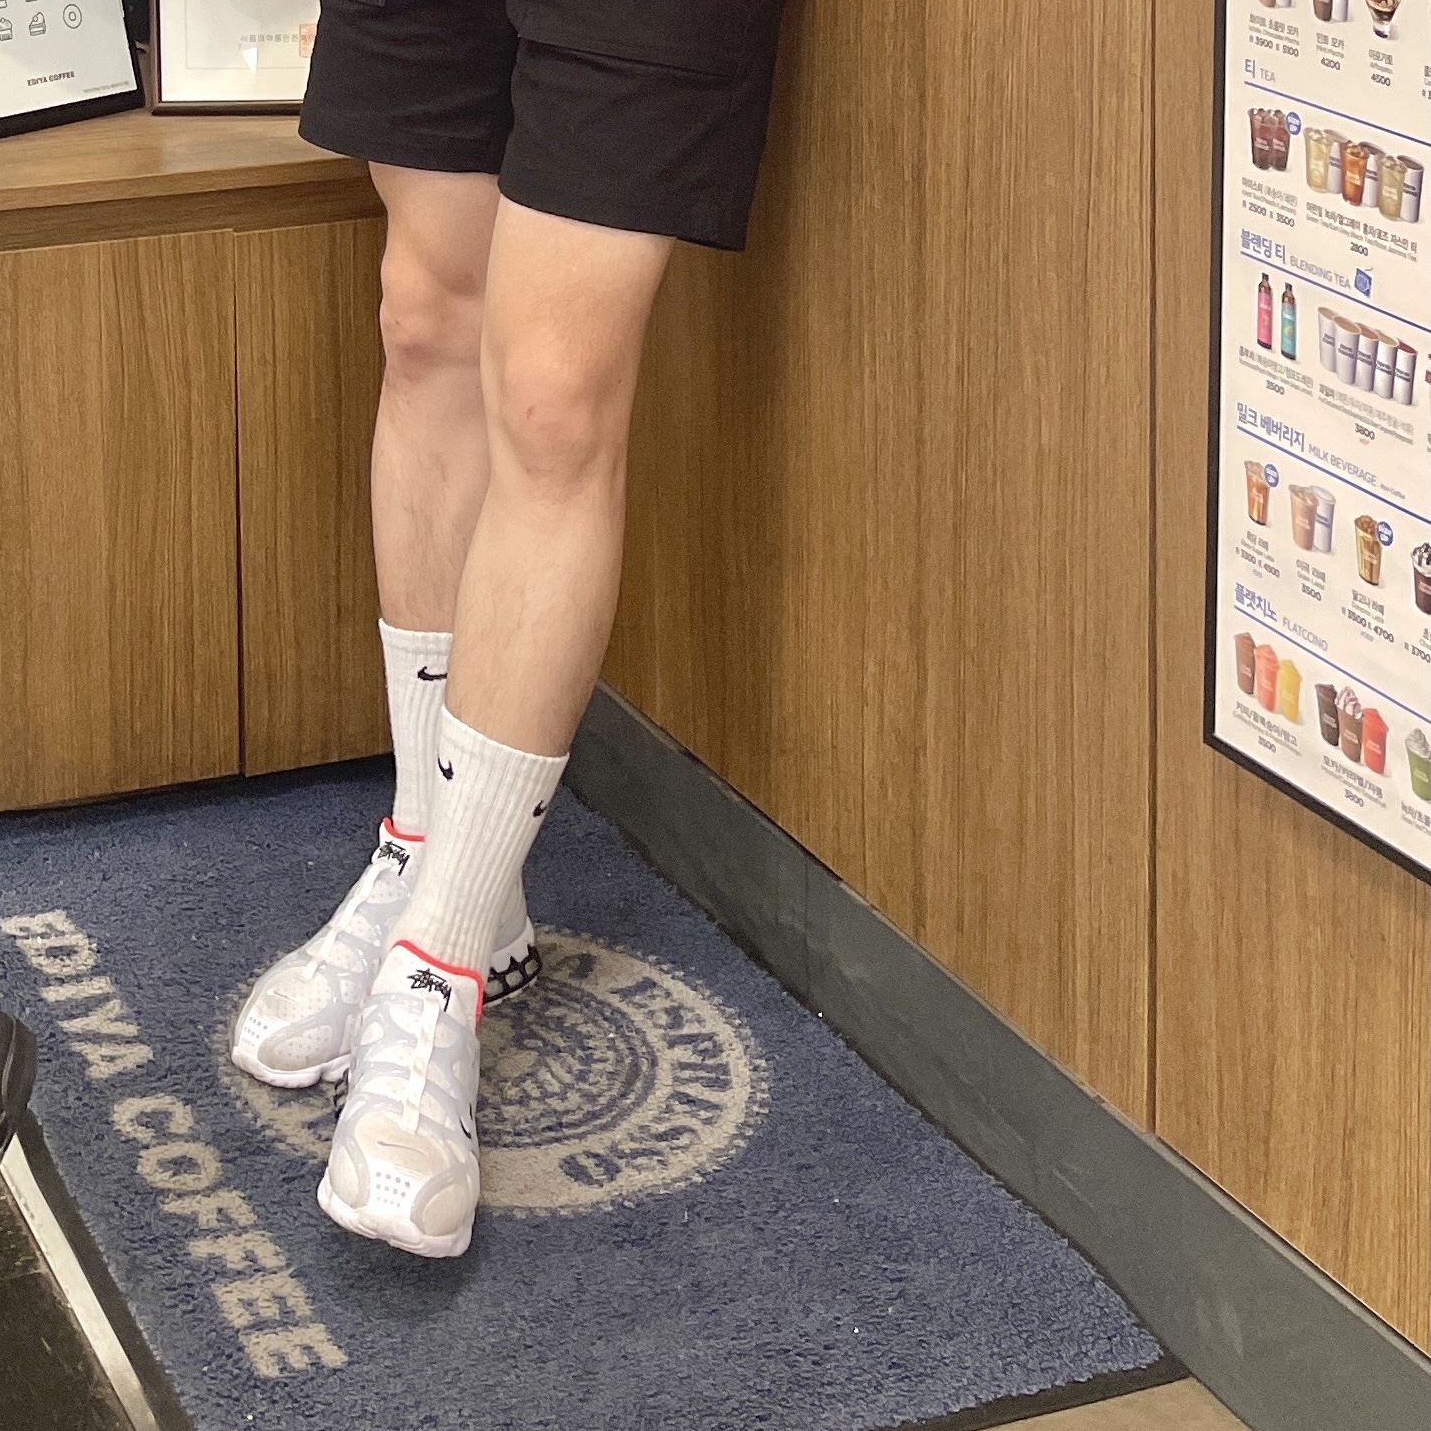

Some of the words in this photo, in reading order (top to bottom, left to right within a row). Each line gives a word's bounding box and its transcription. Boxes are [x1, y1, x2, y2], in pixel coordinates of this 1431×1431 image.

[27, 76, 48, 87] EDIYA
[49, 71, 75, 82] COFFEE
[1244, 58, 1256, 79] 티
[1260, 67, 1276, 83] TEA
[1240, 228, 1273, 259] 블렌딩
[1274, 242, 1286, 264] 티
[1290, 255, 1333, 281] BLENDING
[1334, 272, 1351, 290] TEA
[1236, 401, 1259, 428] 밀크
[1260, 414, 1305, 453] 베버리지
[1308, 443, 1328, 461] MILK
[1330, 451, 1378, 488] BEVERAGE
[1234, 582, 1278, 622] 플랫치노
[1282, 616, 1328, 652] FLATCCINO
[113, 1094, 349, 1379] COFFEE
